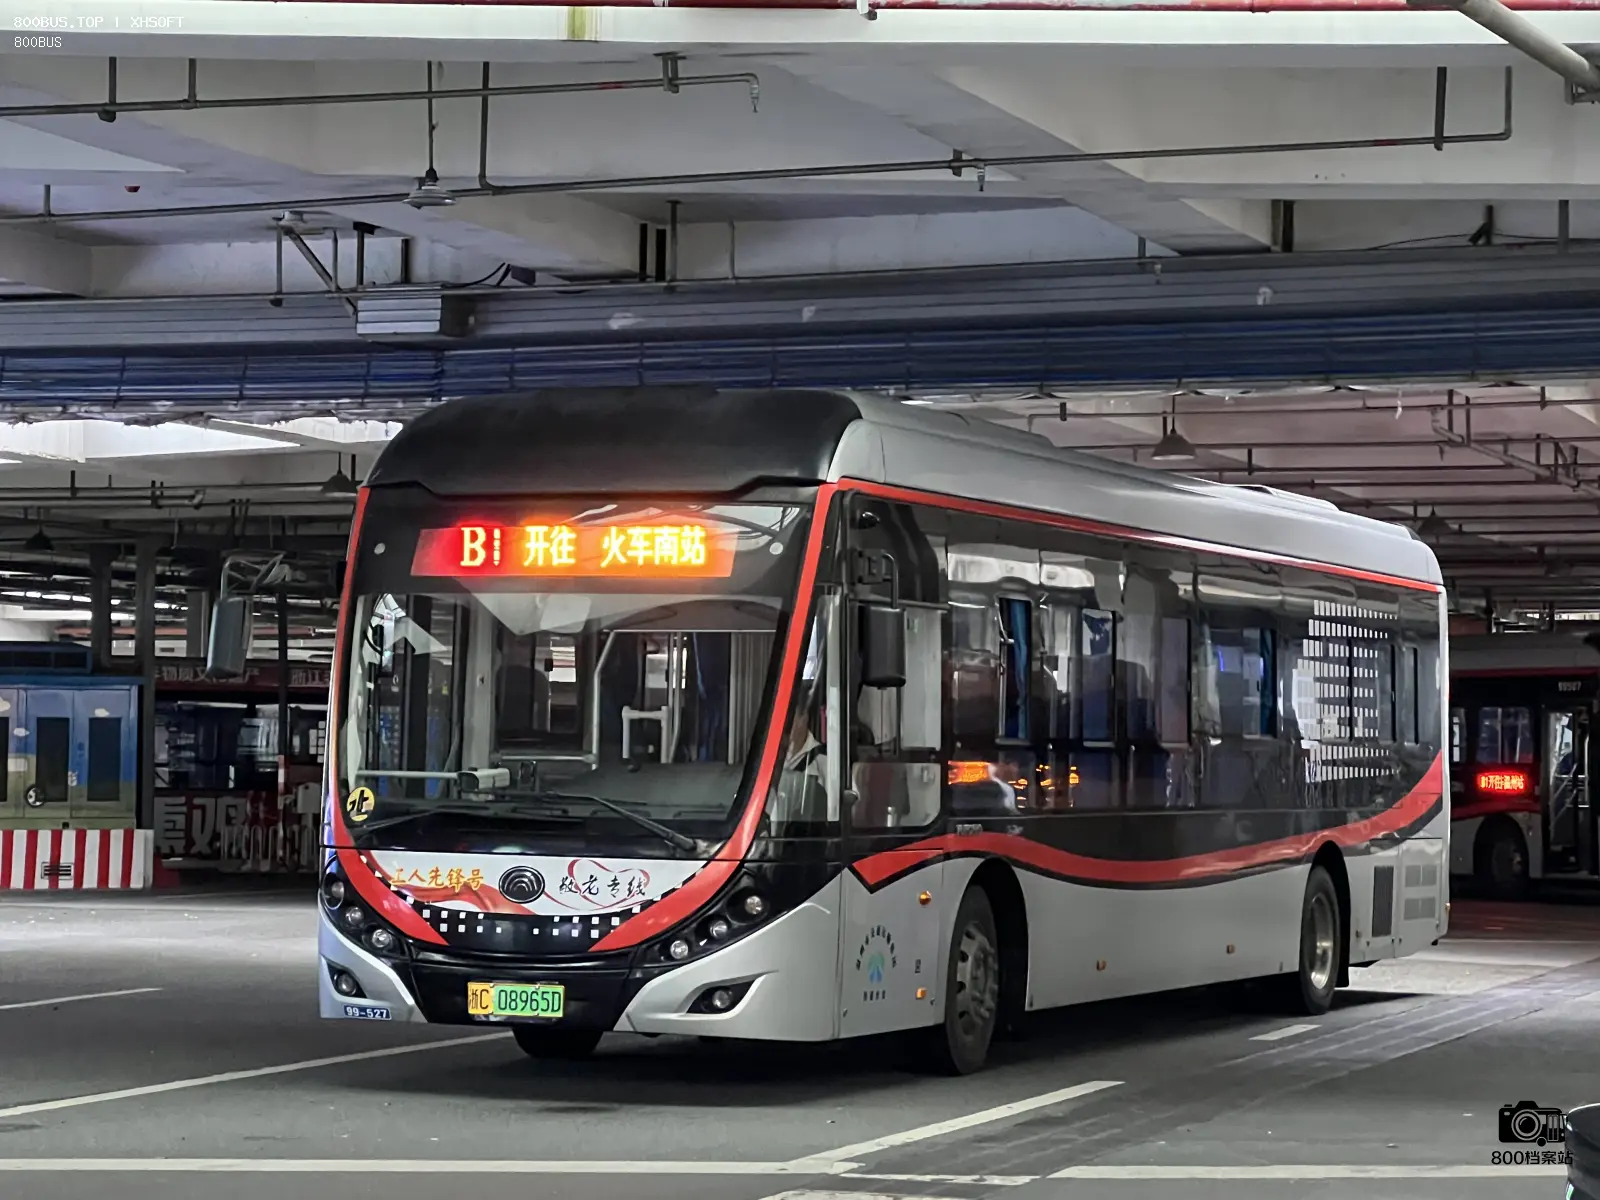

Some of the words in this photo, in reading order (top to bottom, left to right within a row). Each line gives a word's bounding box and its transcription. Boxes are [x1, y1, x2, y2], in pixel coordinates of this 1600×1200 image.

[523, 525, 577, 567] 开往
[600, 525, 706, 568] 火车南站
[391, 866, 484, 892] 工人先锋号
[559, 875, 646, 898] 敬老专线
[346, 1006, 387, 1018] 99-527
[498, 989, 562, 1013] 08965D
